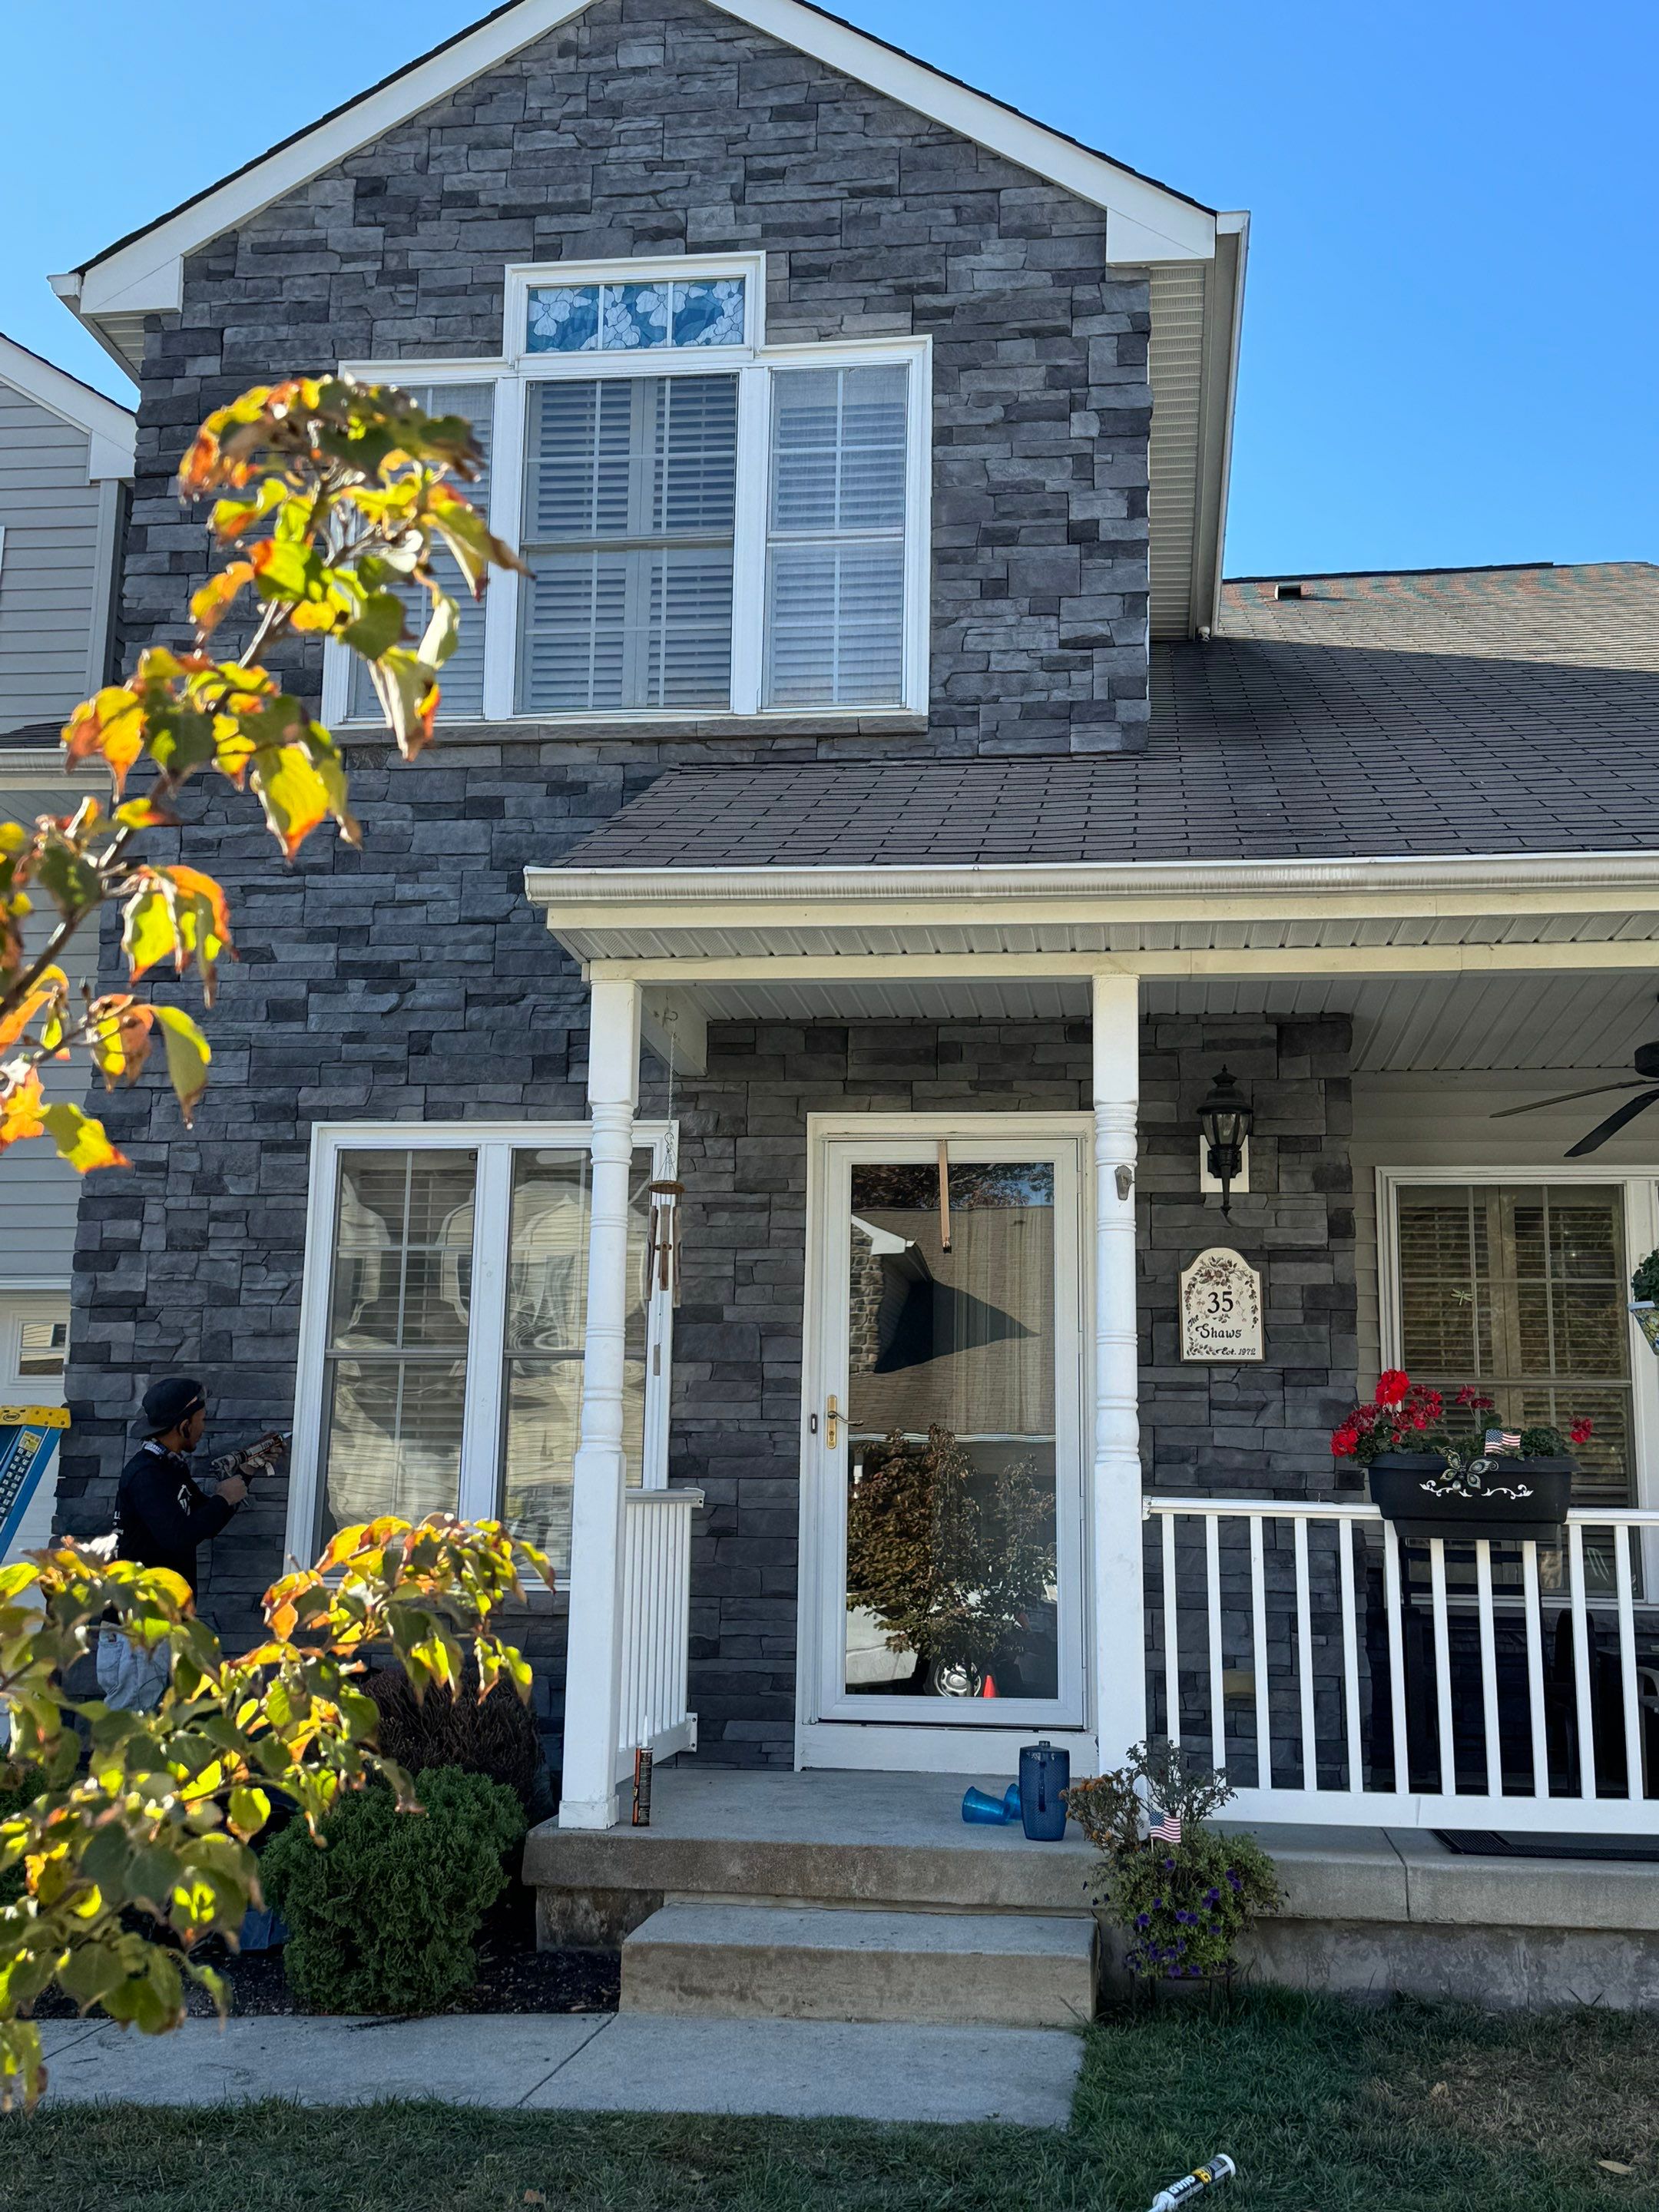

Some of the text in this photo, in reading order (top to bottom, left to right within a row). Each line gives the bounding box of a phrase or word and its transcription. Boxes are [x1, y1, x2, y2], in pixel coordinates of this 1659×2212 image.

[1207, 1291, 1233, 1313] 35
[1187, 1314, 1200, 1327] The
[1195, 1323, 1242, 1338] Shaws
[1216, 1346, 1236, 1355] Est.
[1168, 2175, 1196, 2194] QUAD
